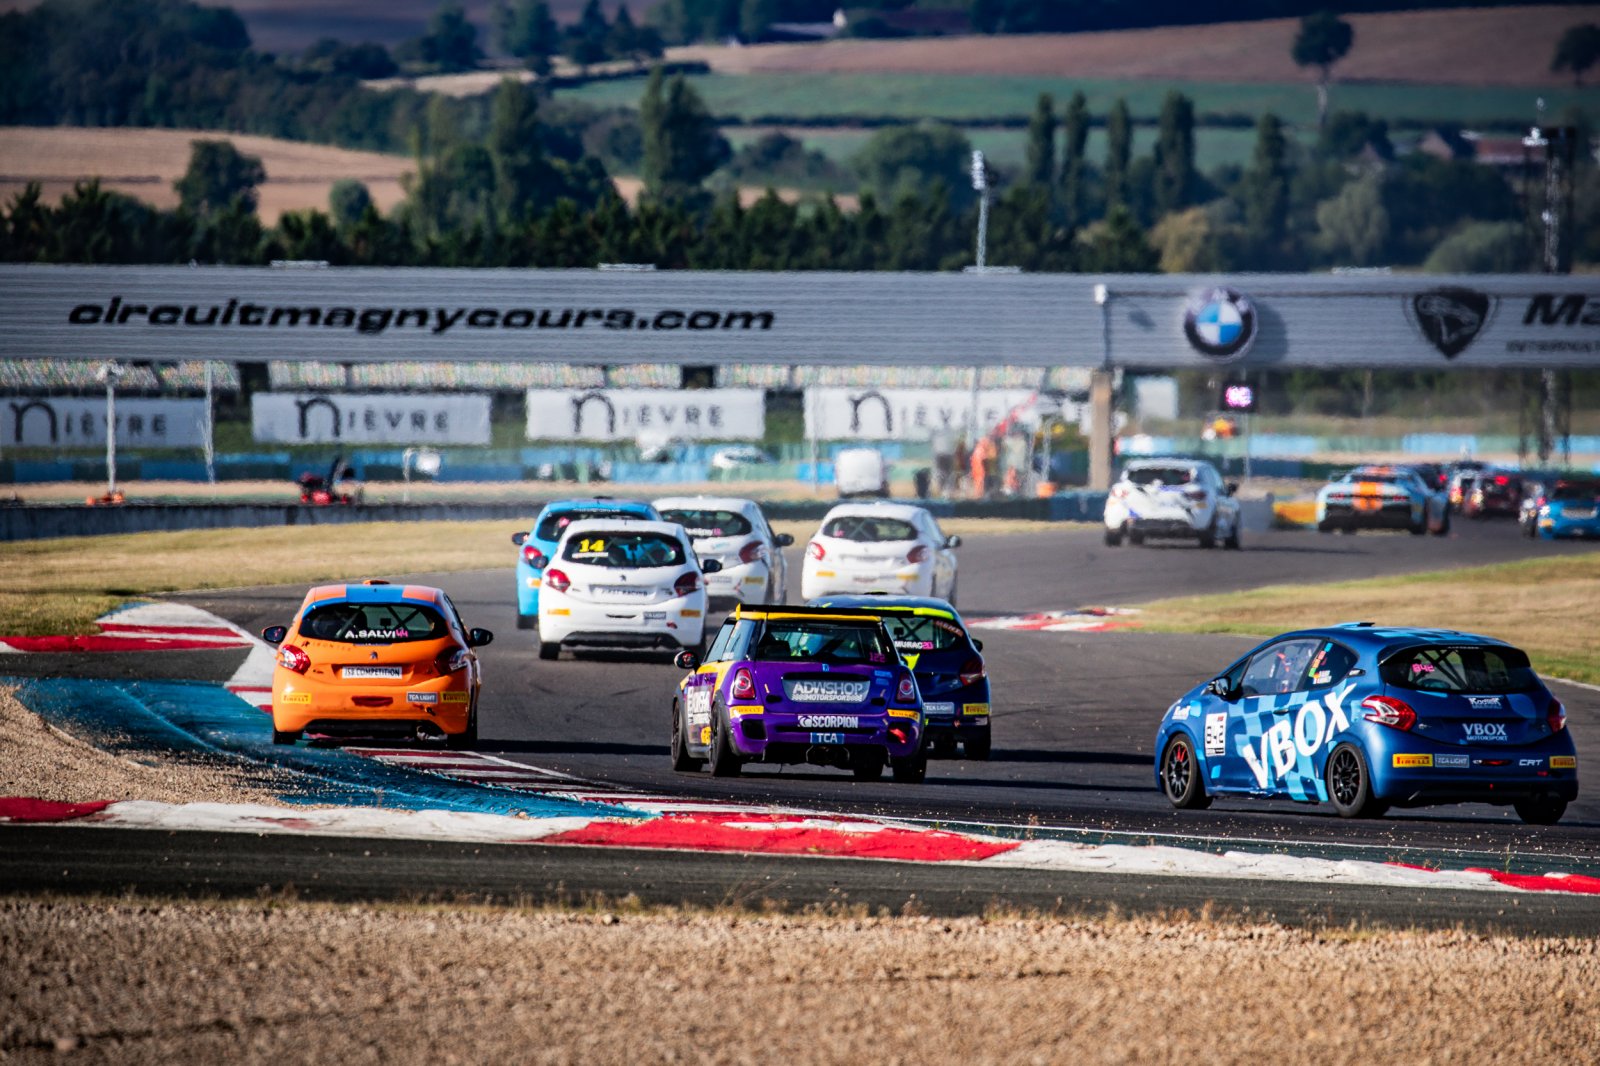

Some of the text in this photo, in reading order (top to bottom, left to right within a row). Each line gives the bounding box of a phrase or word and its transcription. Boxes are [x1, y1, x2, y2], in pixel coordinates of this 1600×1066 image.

[68, 296, 775, 335] circuitmagnycours.com
[579, 539, 604, 553] 14
[793, 682, 863, 696] ADWSHOP
[812, 716, 859, 728] SCORPION
[1462, 723, 1507, 736] VBOX
[816, 732, 838, 743] TCA
[1242, 683, 1358, 790] VBOX
[1396, 755, 1431, 765] PIRELLI
